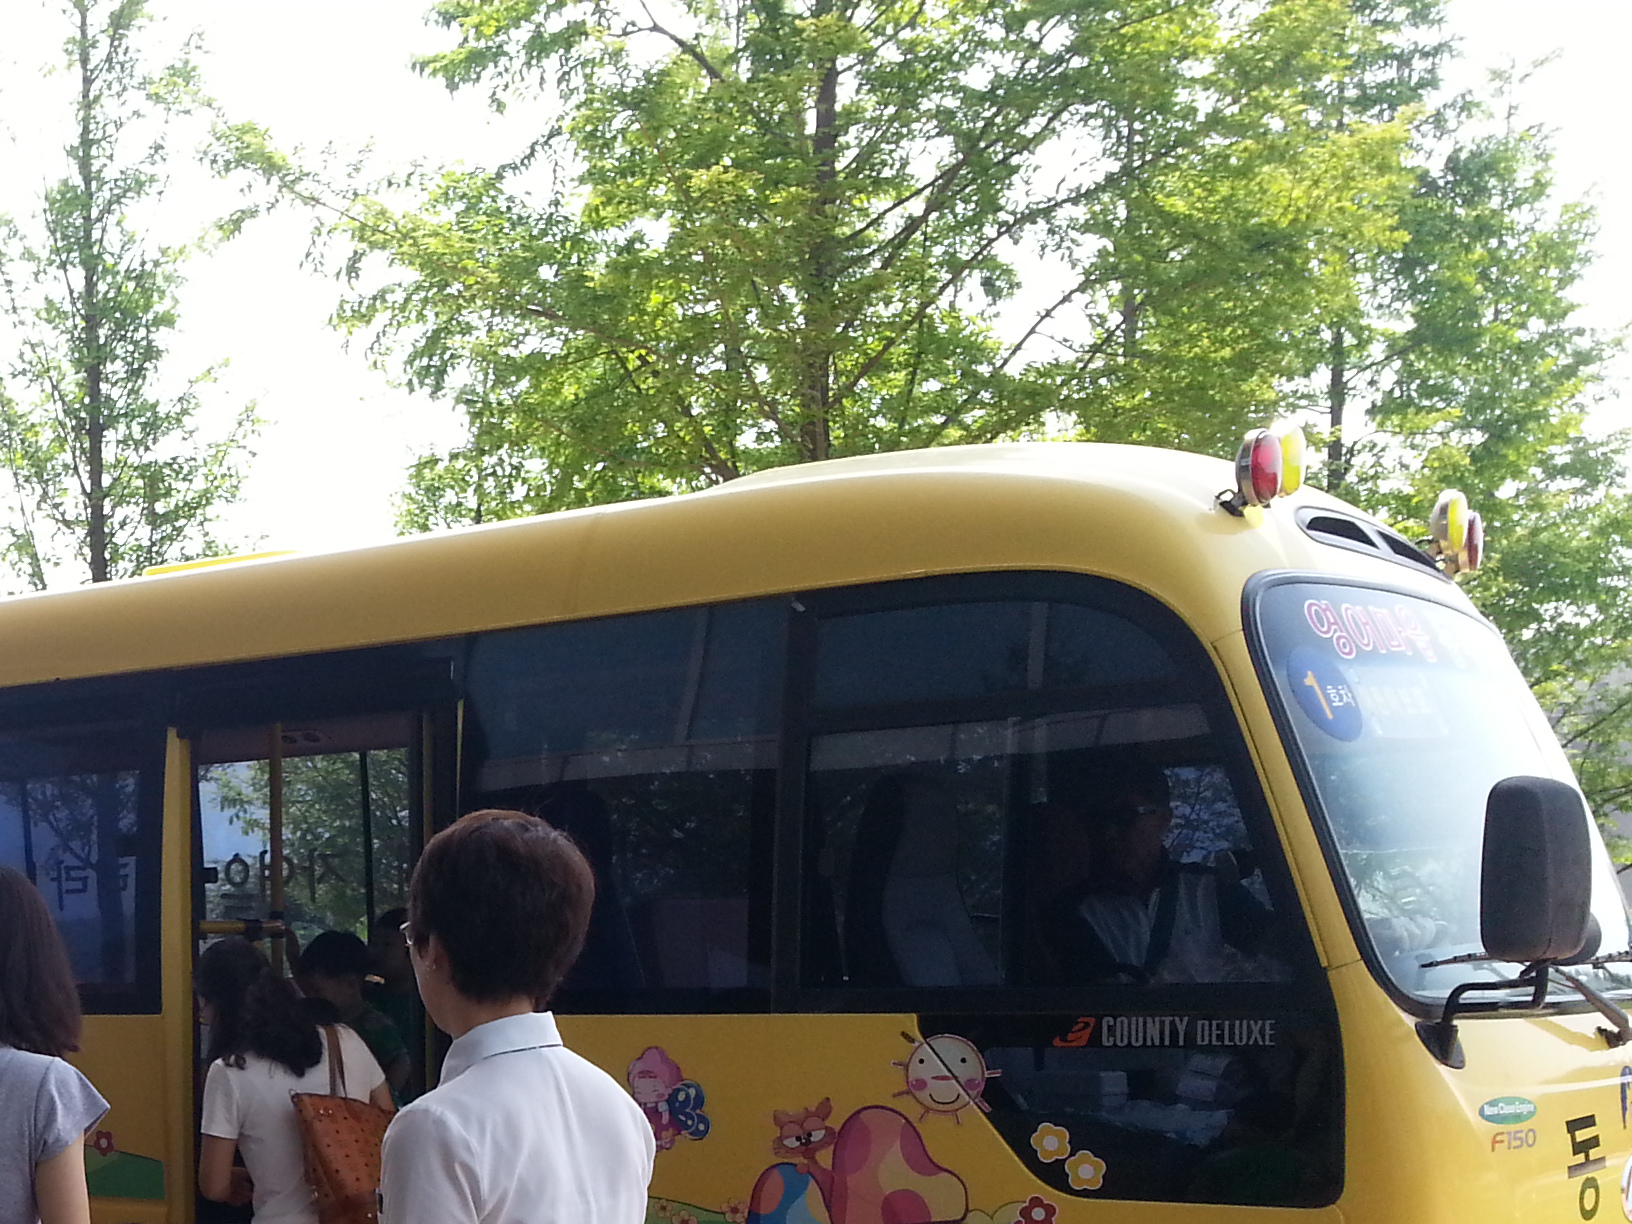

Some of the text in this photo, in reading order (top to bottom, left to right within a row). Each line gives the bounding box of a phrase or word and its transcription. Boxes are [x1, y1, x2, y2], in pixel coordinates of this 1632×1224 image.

[1101, 1016, 1277, 1047] COUNTY DELUXE
[1491, 1128, 1537, 1153] F150
[1565, 1114, 1607, 1222] 동
